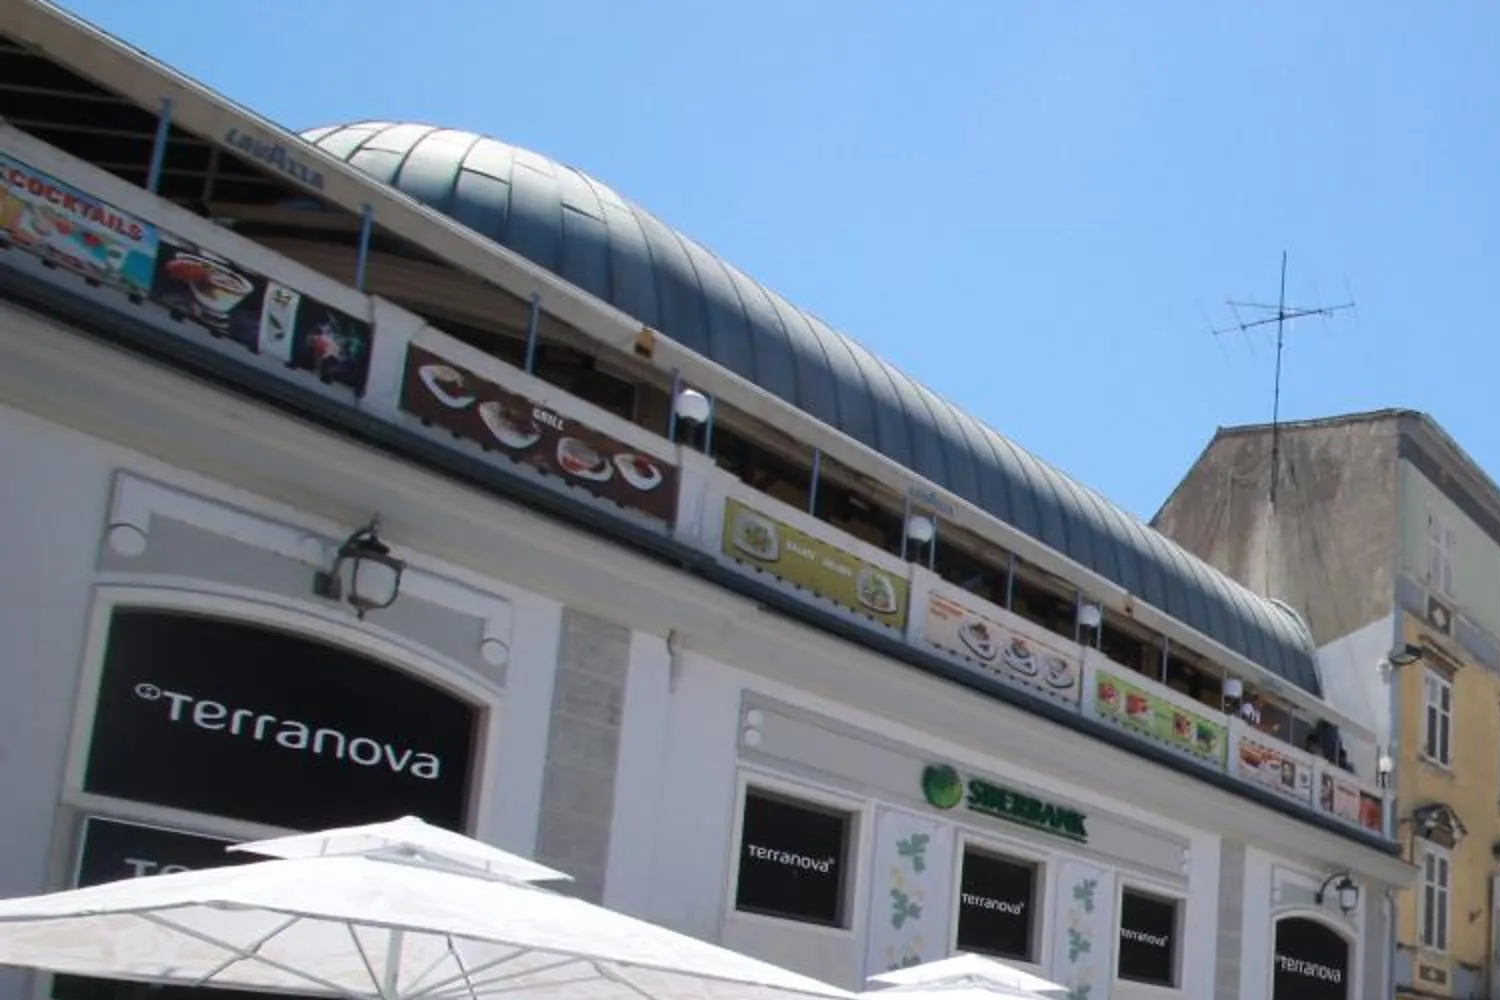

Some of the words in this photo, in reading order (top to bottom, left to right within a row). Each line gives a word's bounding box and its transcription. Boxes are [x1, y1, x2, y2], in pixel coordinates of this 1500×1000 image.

[8, 168, 143, 241] COCKTAILS
[163, 691, 440, 780] Terranova
[967, 778, 1088, 838] SBERBANK
[747, 844, 830, 873] Terranova
[961, 892, 1022, 915] Terranova
[1279, 955, 1341, 984] Terranova
